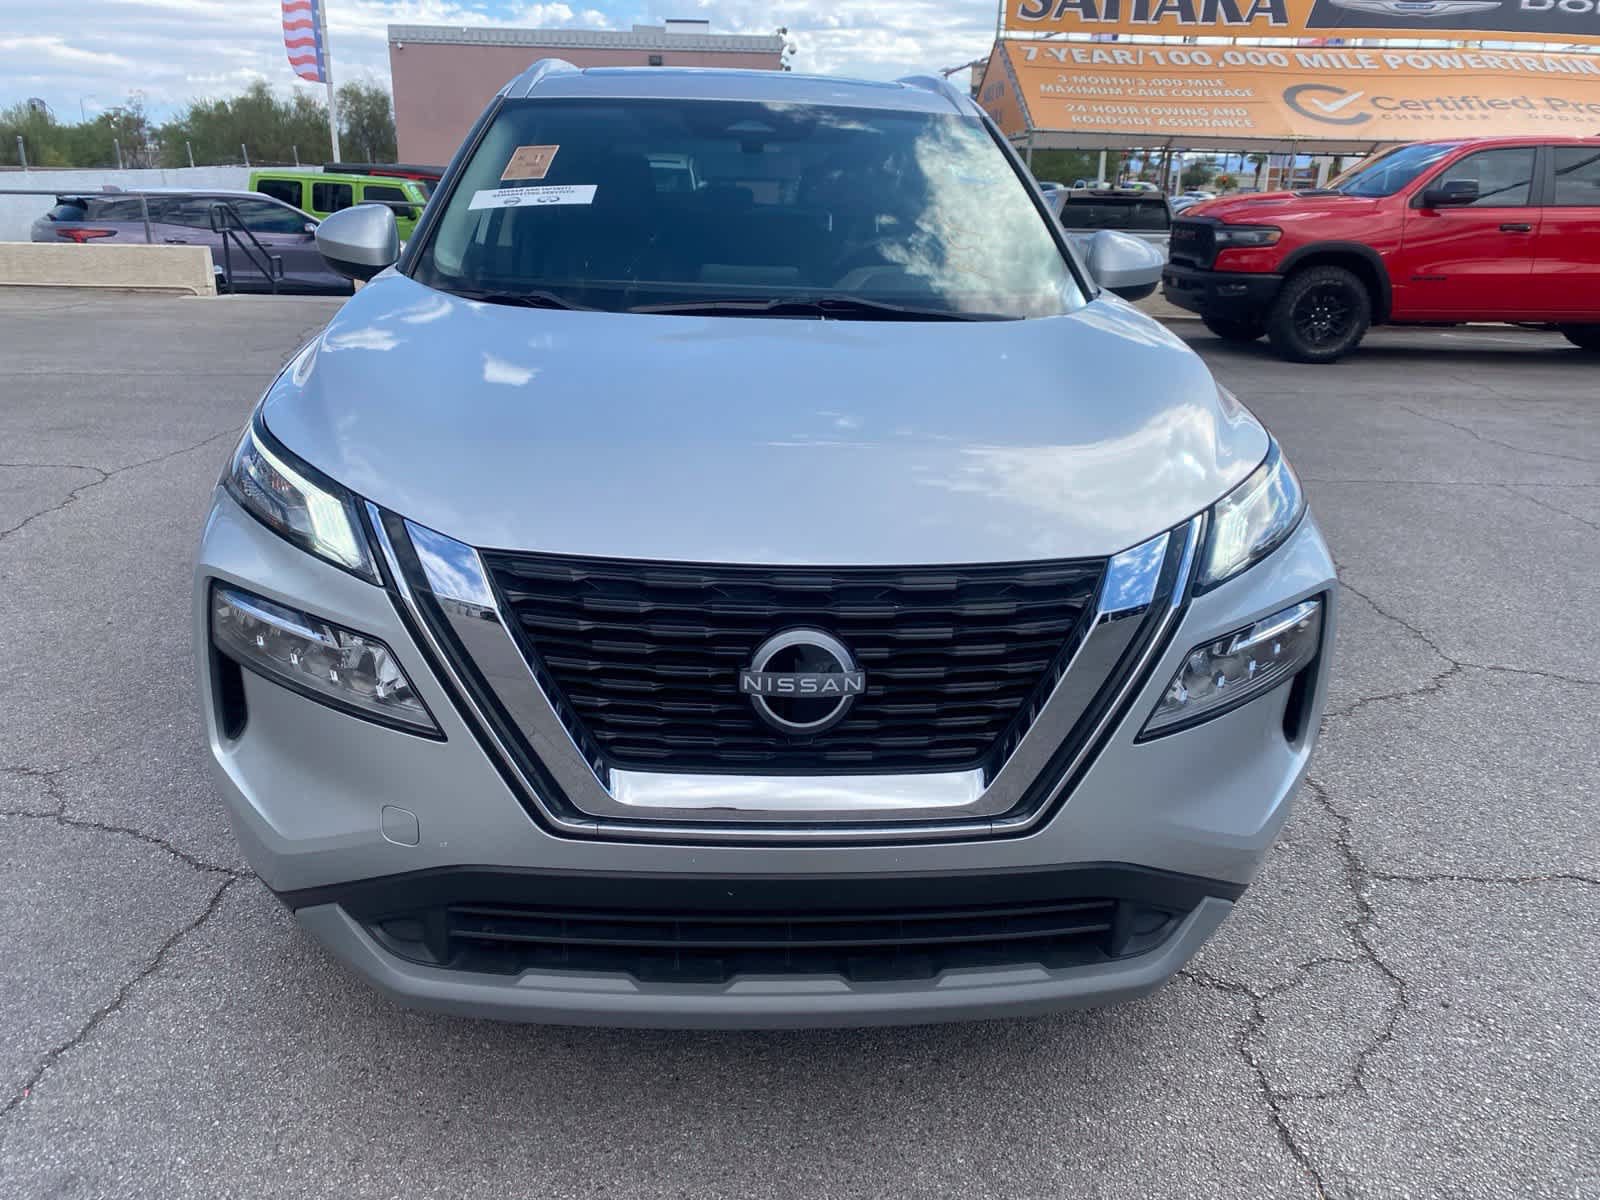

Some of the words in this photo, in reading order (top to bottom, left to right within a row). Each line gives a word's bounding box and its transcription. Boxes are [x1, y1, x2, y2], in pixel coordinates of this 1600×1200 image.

[1295, 52, 1379, 69] MILE
[1383, 53, 1600, 76] POWERTRAIN
[1039, 83, 1123, 96] MAXIMUM
[1171, 88, 1255, 97] COVERAGE
[1370, 95, 1537, 111] Certified
[1144, 105, 1209, 116] TOWING
[1213, 107, 1249, 117] AND
[1071, 114, 1153, 126] ROADSIDE
[1159, 117, 1255, 128] ASSISTANCE
[743, 675, 861, 692] NISSAN
